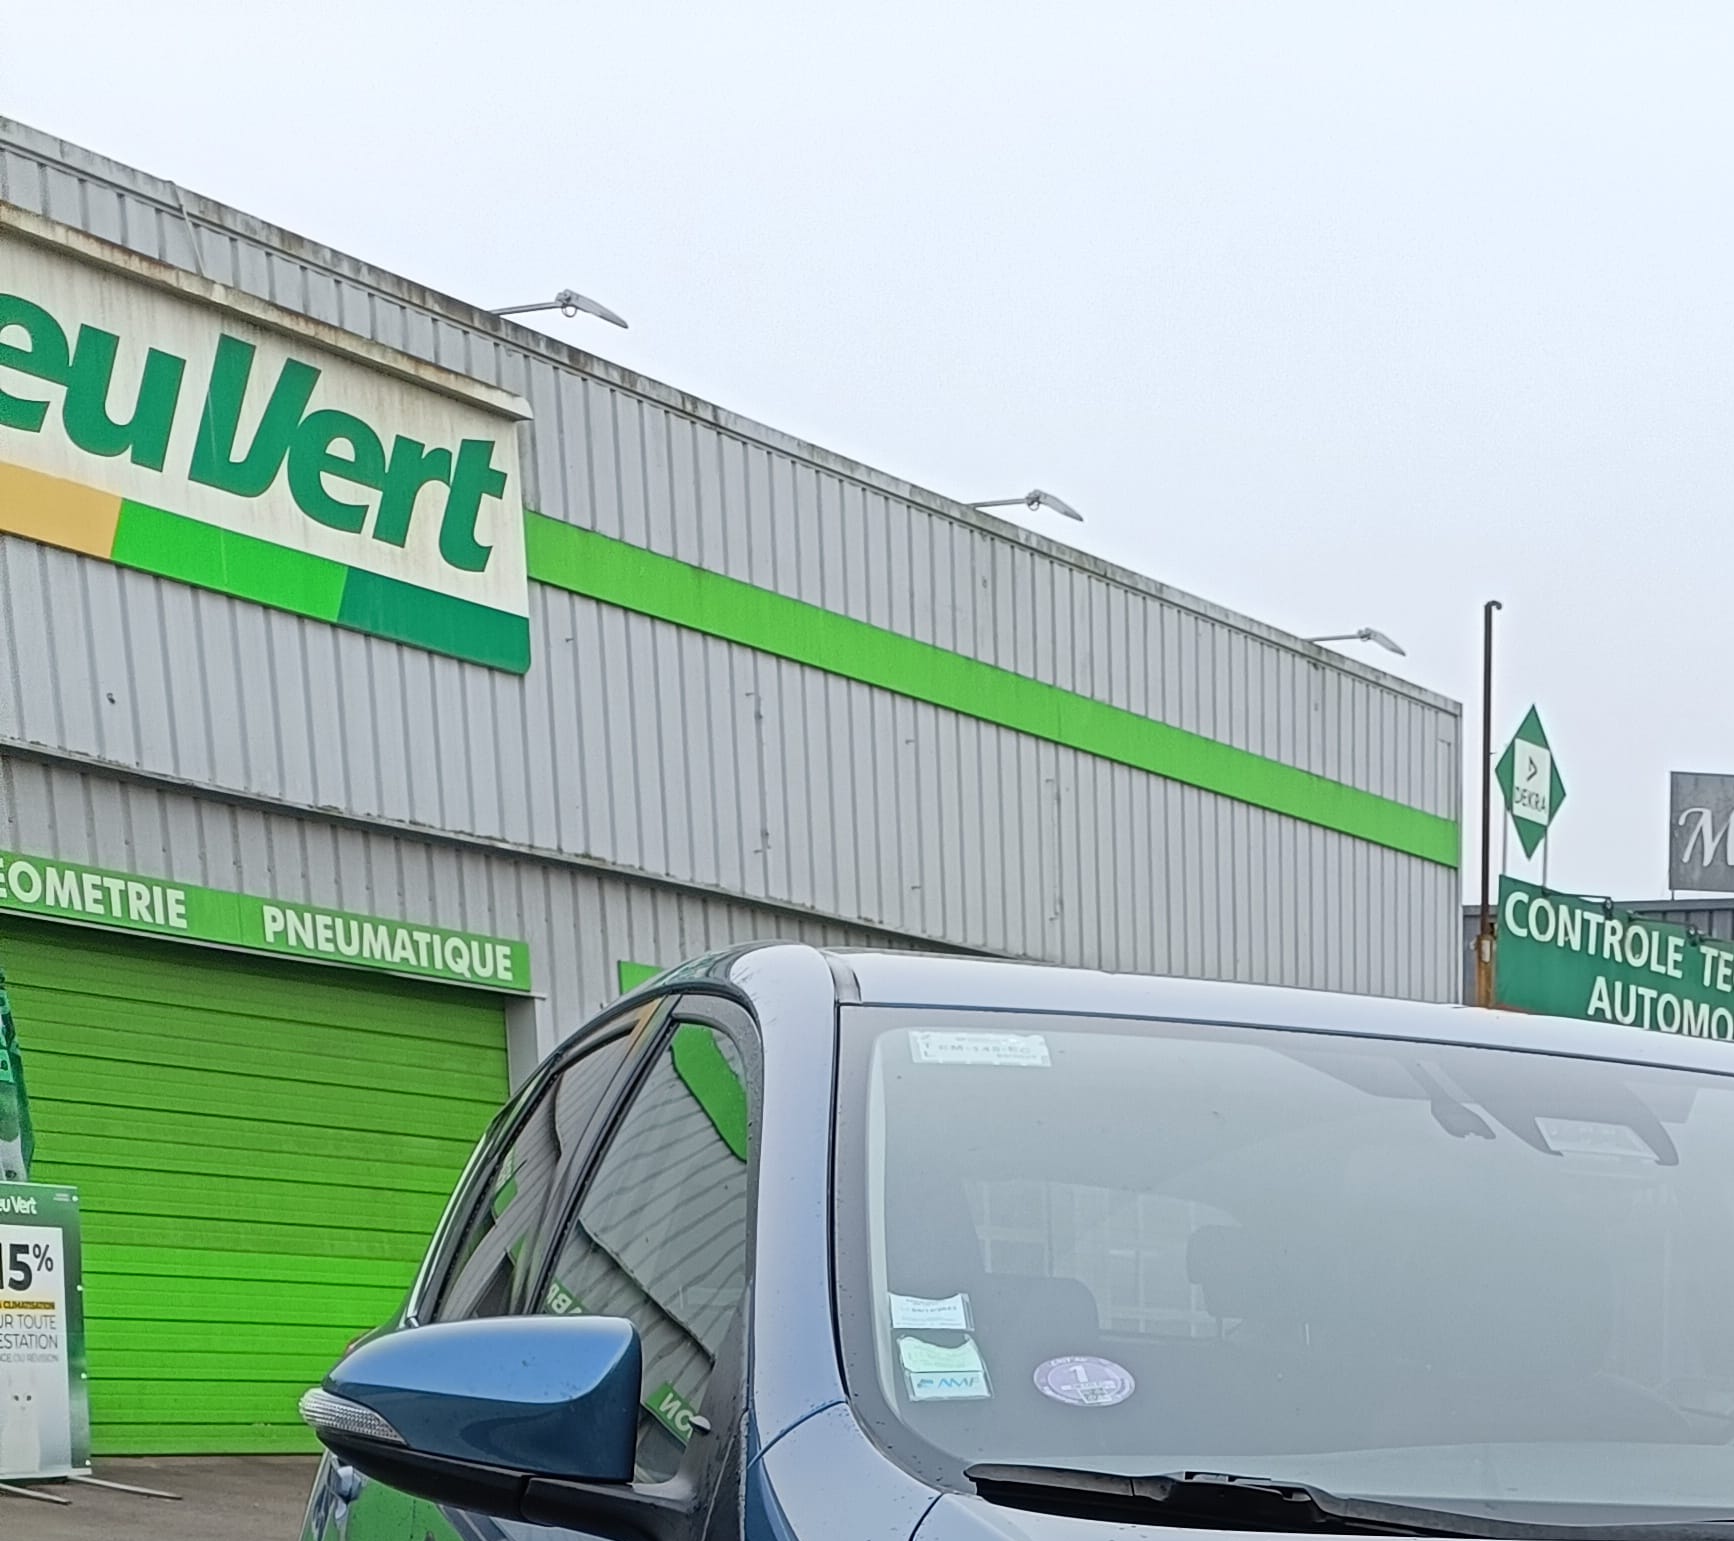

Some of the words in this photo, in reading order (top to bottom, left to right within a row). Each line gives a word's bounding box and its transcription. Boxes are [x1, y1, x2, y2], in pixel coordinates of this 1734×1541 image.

[188, 333, 508, 573] Vert
[263, 905, 514, 981] PNEUMATIQUE
[1504, 892, 1685, 979] CONTROLE
[0, 1243, 54, 1292] 5%
[16, 1313, 57, 1330] TOUTE
